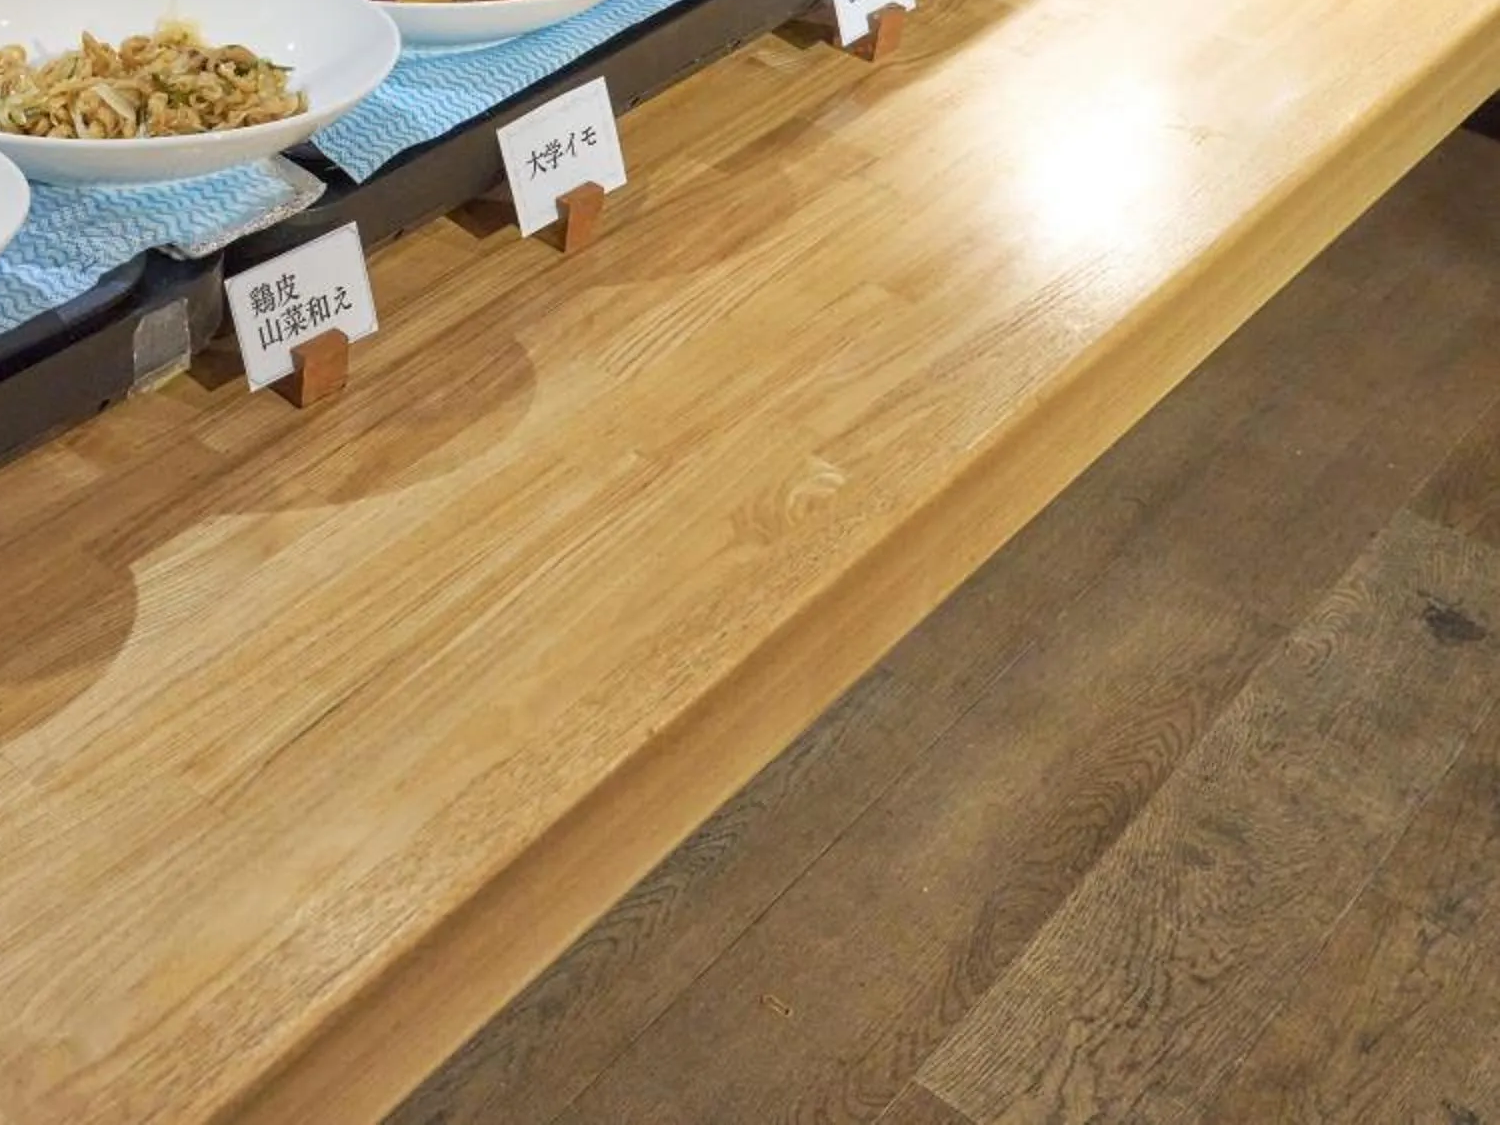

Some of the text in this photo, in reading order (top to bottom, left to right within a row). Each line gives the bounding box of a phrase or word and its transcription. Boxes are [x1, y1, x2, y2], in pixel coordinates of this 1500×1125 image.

[525, 125, 598, 182] 大学イモ
[249, 273, 300, 317] 鶏皮
[258, 285, 353, 352] 山菜和え
